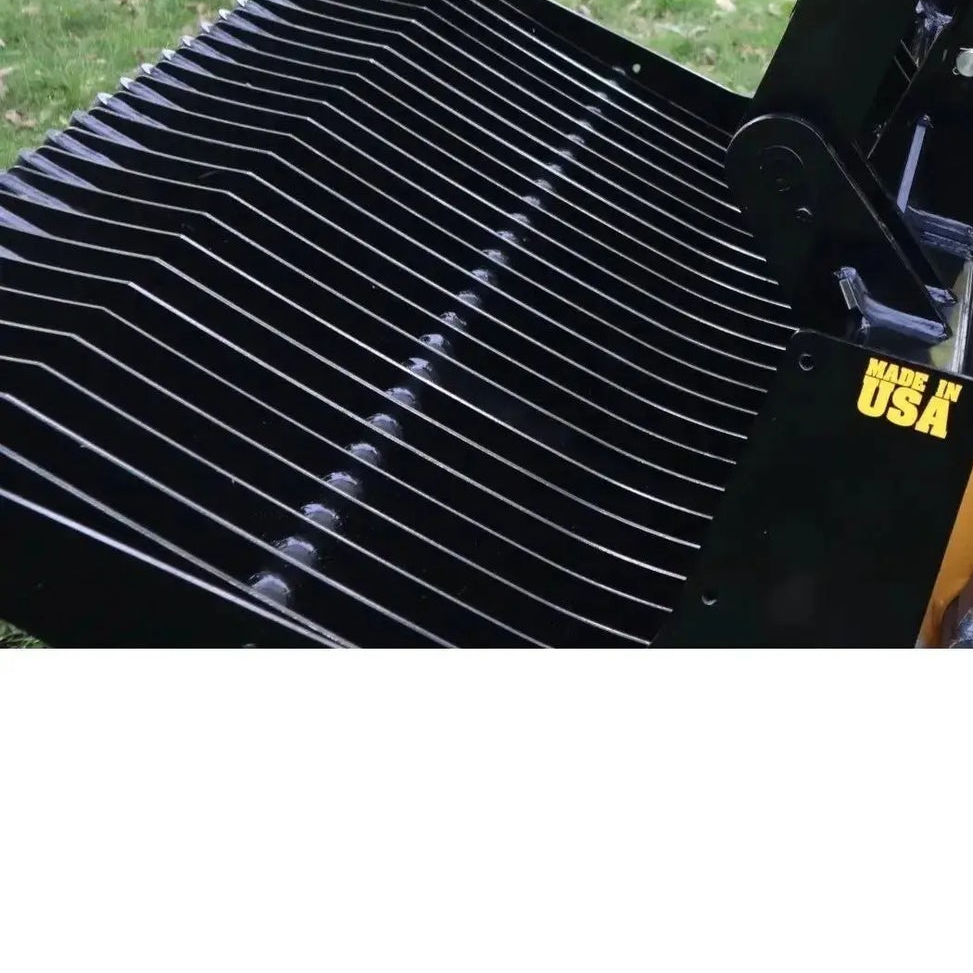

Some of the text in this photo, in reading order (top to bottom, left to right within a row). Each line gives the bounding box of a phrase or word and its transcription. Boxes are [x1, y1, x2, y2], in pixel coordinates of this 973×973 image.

[857, 375, 950, 439] USA
[865, 357, 963, 403] MADE IN
